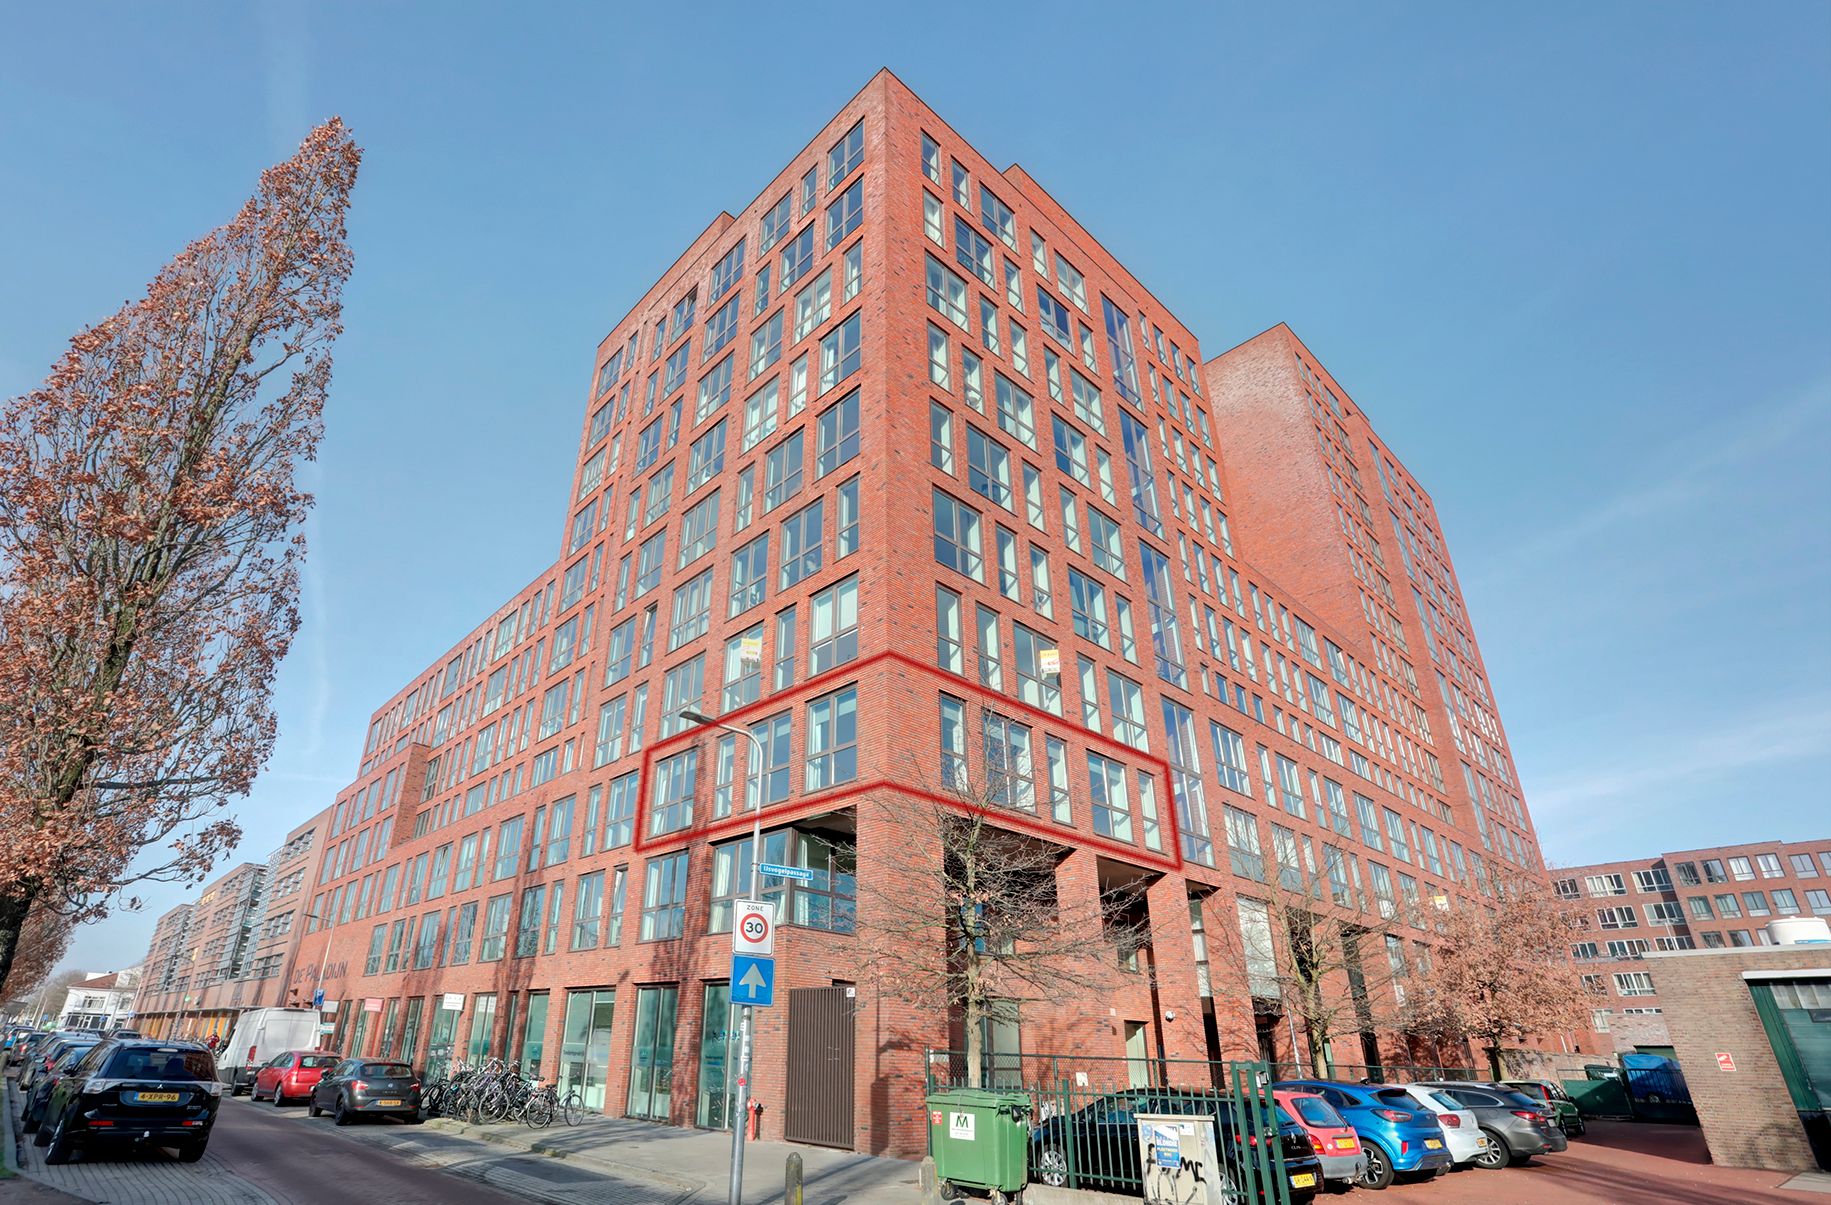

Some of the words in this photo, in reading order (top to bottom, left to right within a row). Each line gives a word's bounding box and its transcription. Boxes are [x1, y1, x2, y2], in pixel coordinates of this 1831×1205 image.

[746, 904, 764, 912] ZONE
[745, 922, 764, 934] 30
[306, 960, 348, 982] PALDIJN
[140, 1093, 177, 1101] 4-XPR-96
